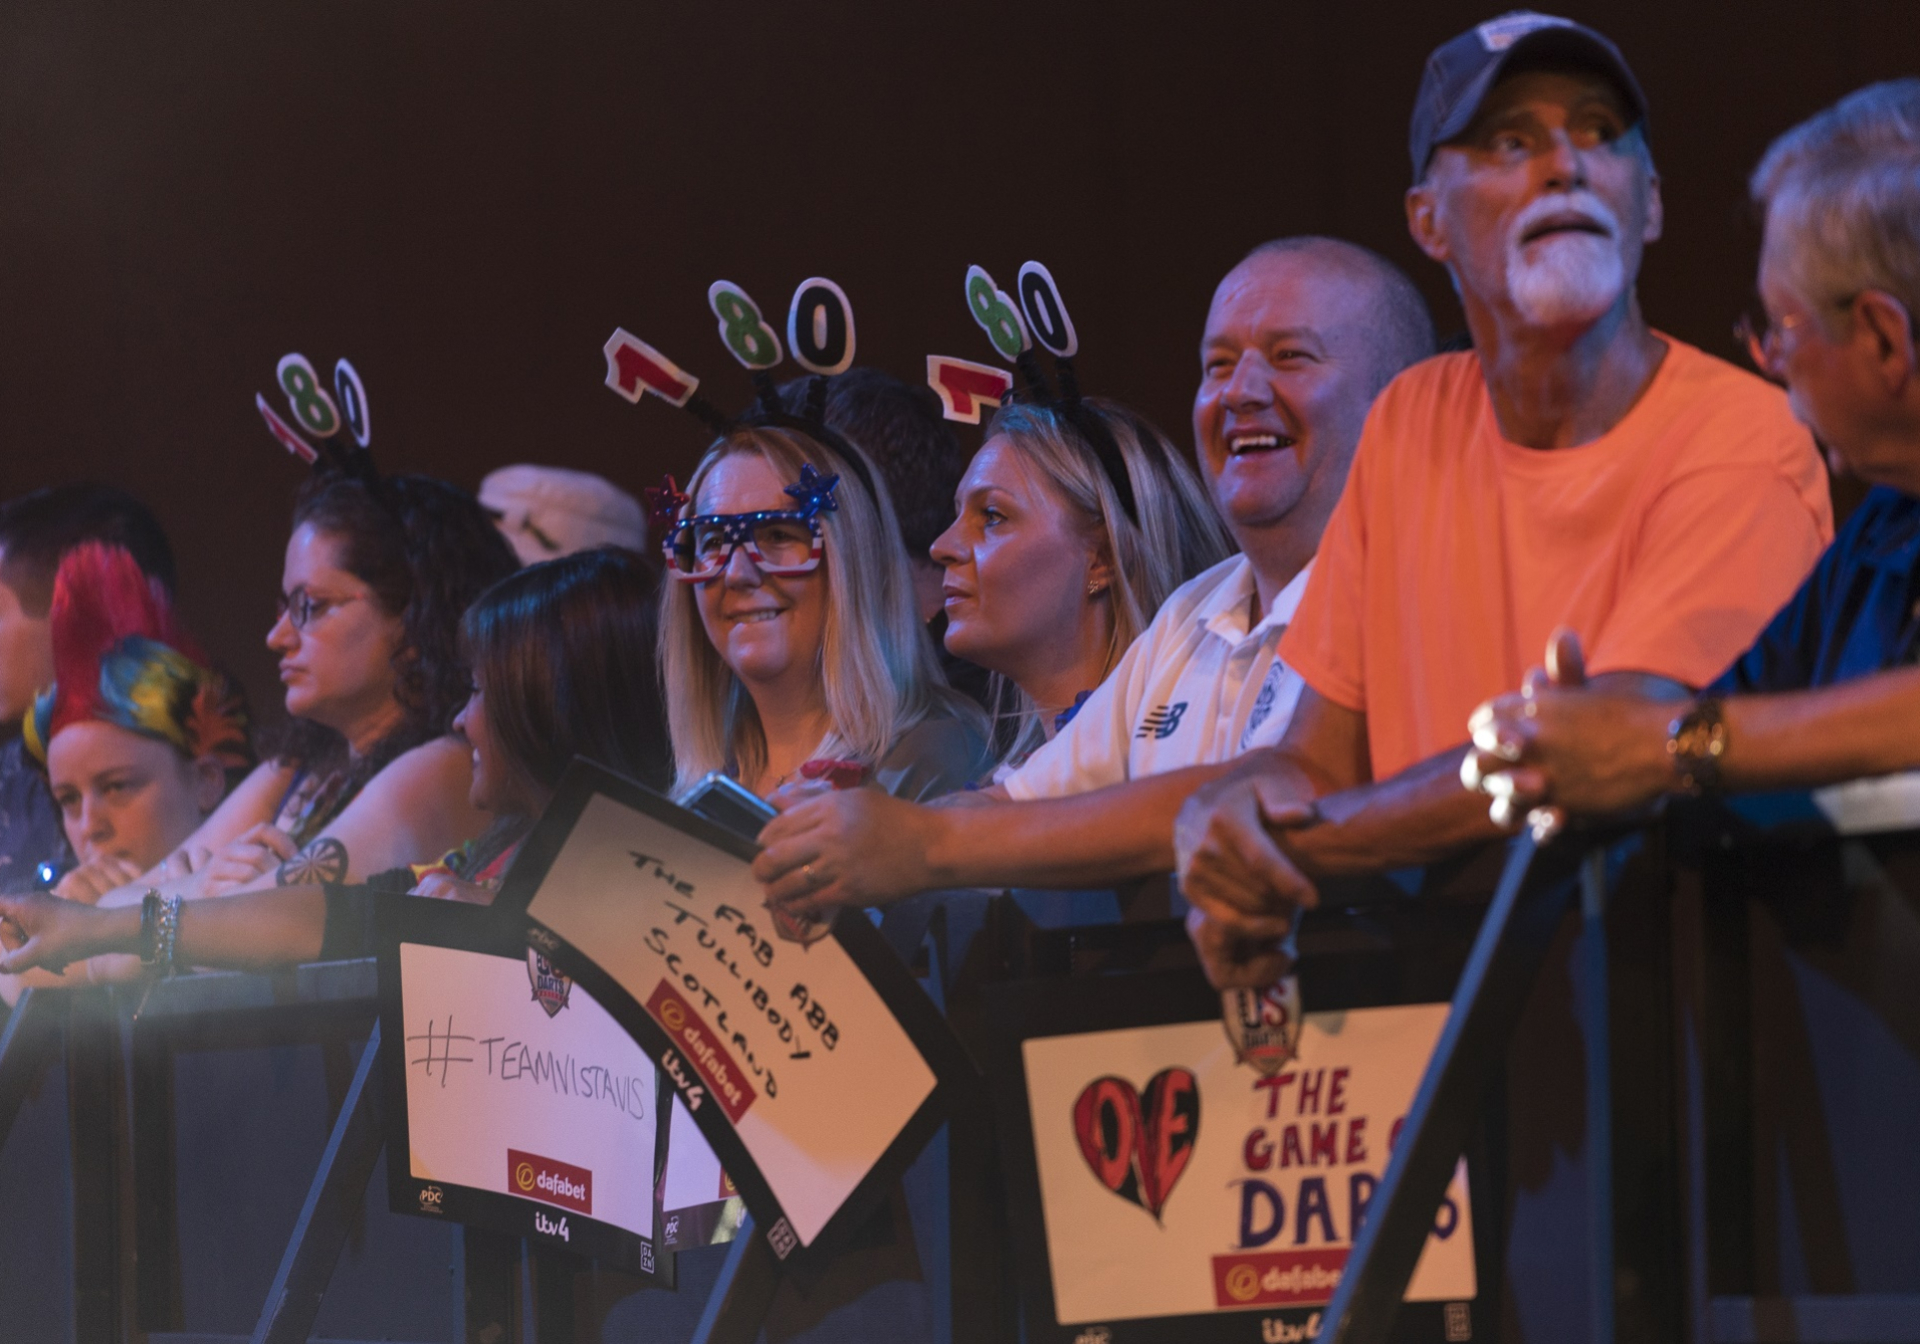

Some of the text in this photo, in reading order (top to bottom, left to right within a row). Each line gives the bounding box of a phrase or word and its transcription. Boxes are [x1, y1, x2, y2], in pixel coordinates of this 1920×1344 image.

[603, 277, 856, 408] 180
[629, 851, 696, 899] THE
[714, 903, 774, 968] FAB
[790, 982, 840, 1052] ABB
[537, 974, 565, 994] DARTS
[664, 900, 812, 1060] TULLIBODY
[643, 927, 777, 1099] SCOTLAND
[661, 1048, 704, 1111] itv4
[684, 1027, 742, 1107] dafabet
[1253, 1066, 1350, 1120] THE
[1243, 1116, 1368, 1172] GAME
[421, 1189, 441, 1204] PDC
[536, 1173, 586, 1201] dafabet
[1228, 1172, 1459, 1249] DARS
[535, 1211, 570, 1242] itv4
[665, 1221, 679, 1234] PDC
[1262, 1264, 1341, 1293] dafabe
